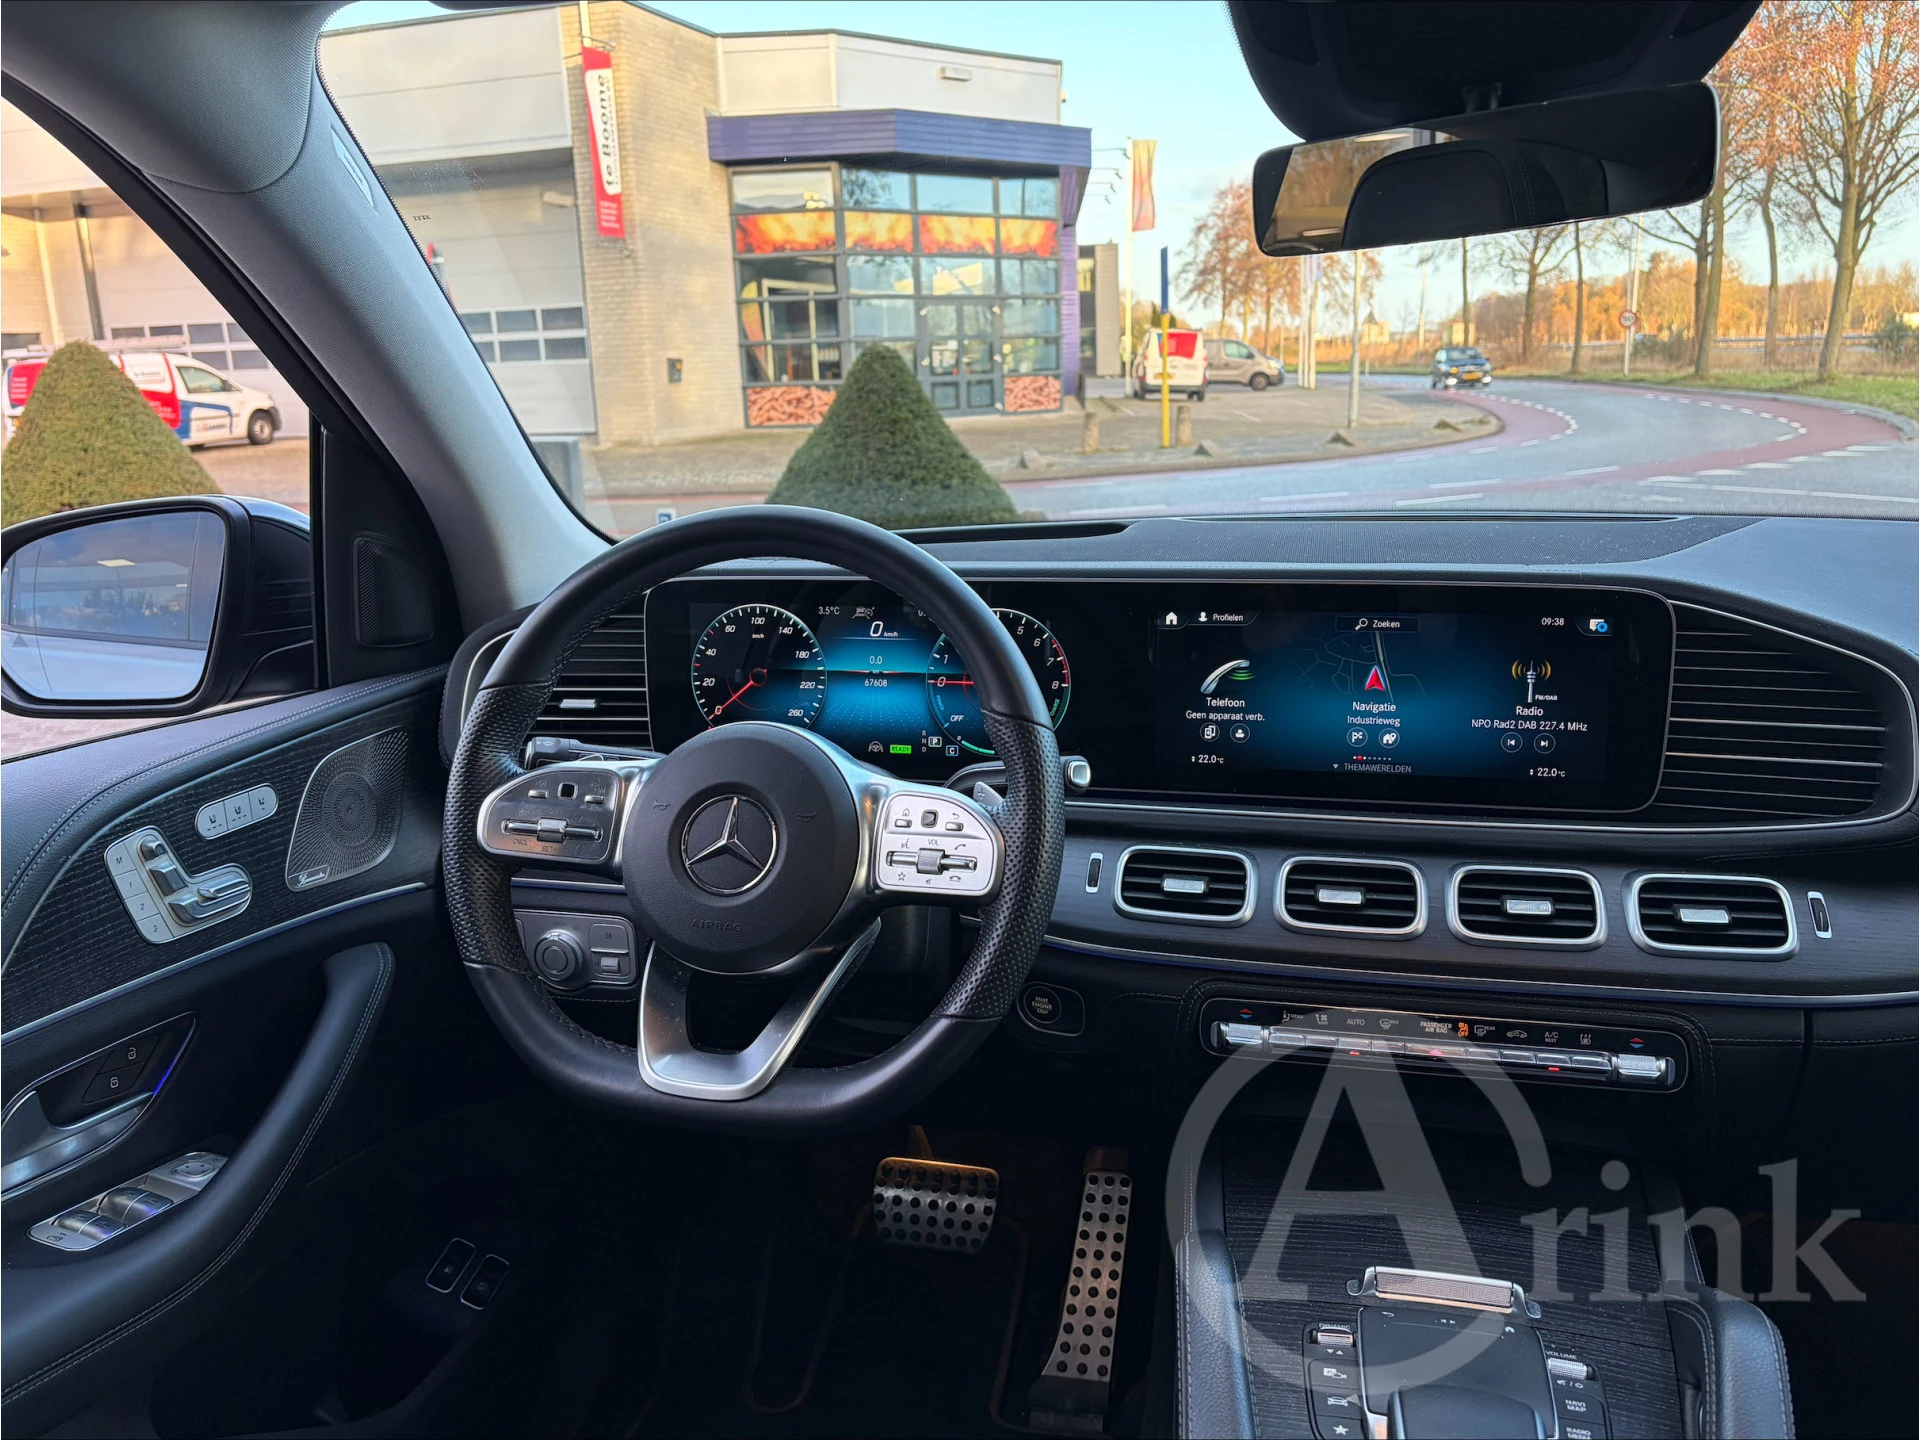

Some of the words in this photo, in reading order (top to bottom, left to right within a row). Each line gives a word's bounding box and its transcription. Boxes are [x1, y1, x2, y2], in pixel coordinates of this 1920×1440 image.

[818, 606, 840, 615] 3.5°C
[751, 617, 765, 625] 100
[1212, 613, 1243, 622] Profielen
[1541, 617, 1564, 626] 09:38
[1372, 619, 1400, 628] Zoeken
[725, 625, 736, 633] 60
[870, 621, 883, 637] 0
[1017, 626, 1024, 635] 5
[1034, 638, 1041, 647] 6
[706, 648, 717, 656] 40
[795, 651, 810, 659] 180
[869, 656, 883, 665] 0.0
[944, 654, 949, 664] 1
[1046, 657, 1054, 666] 7
[702, 678, 715, 686] 20
[800, 681, 815, 689] 220
[864, 679, 888, 687] 67608
[937, 676, 946, 687] 0
[1052, 681, 1059, 689] 8
[1206, 697, 1245, 707] Telefoon
[715, 705, 722, 715] 0
[1352, 701, 1396, 713] Navigatie
[1516, 706, 1543, 716] Radio
[788, 709, 803, 717] 260
[1185, 710, 1206, 719] Geen
[1208, 711, 1243, 722] apparaat
[1245, 712, 1265, 721] verb.
[950, 714, 964, 722] OFF
[1347, 715, 1400, 727] Industrieweg
[1471, 719, 1491, 729] NPO
[1493, 720, 1516, 729] Rad2
[1518, 721, 1537, 730] DAB
[1539, 721, 1565, 731] 227.4
[1567, 722, 1588, 732] MHz
[1344, 762, 1412, 773] THEMAWERELDEN
[927, 838, 940, 846] VOL
[116, 856, 122, 864] M
[691, 918, 743, 932] AIRBAG
[1346, 1018, 1365, 1026] AUTO
[1420, 1021, 1452, 1029] PASSENGER
[1544, 1031, 1559, 1039] A/C
[1545, 1350, 1577, 1360] VOLUME
[1565, 1399, 1586, 1407] NAVI
[1566, 1427, 1591, 1436] RADIO
